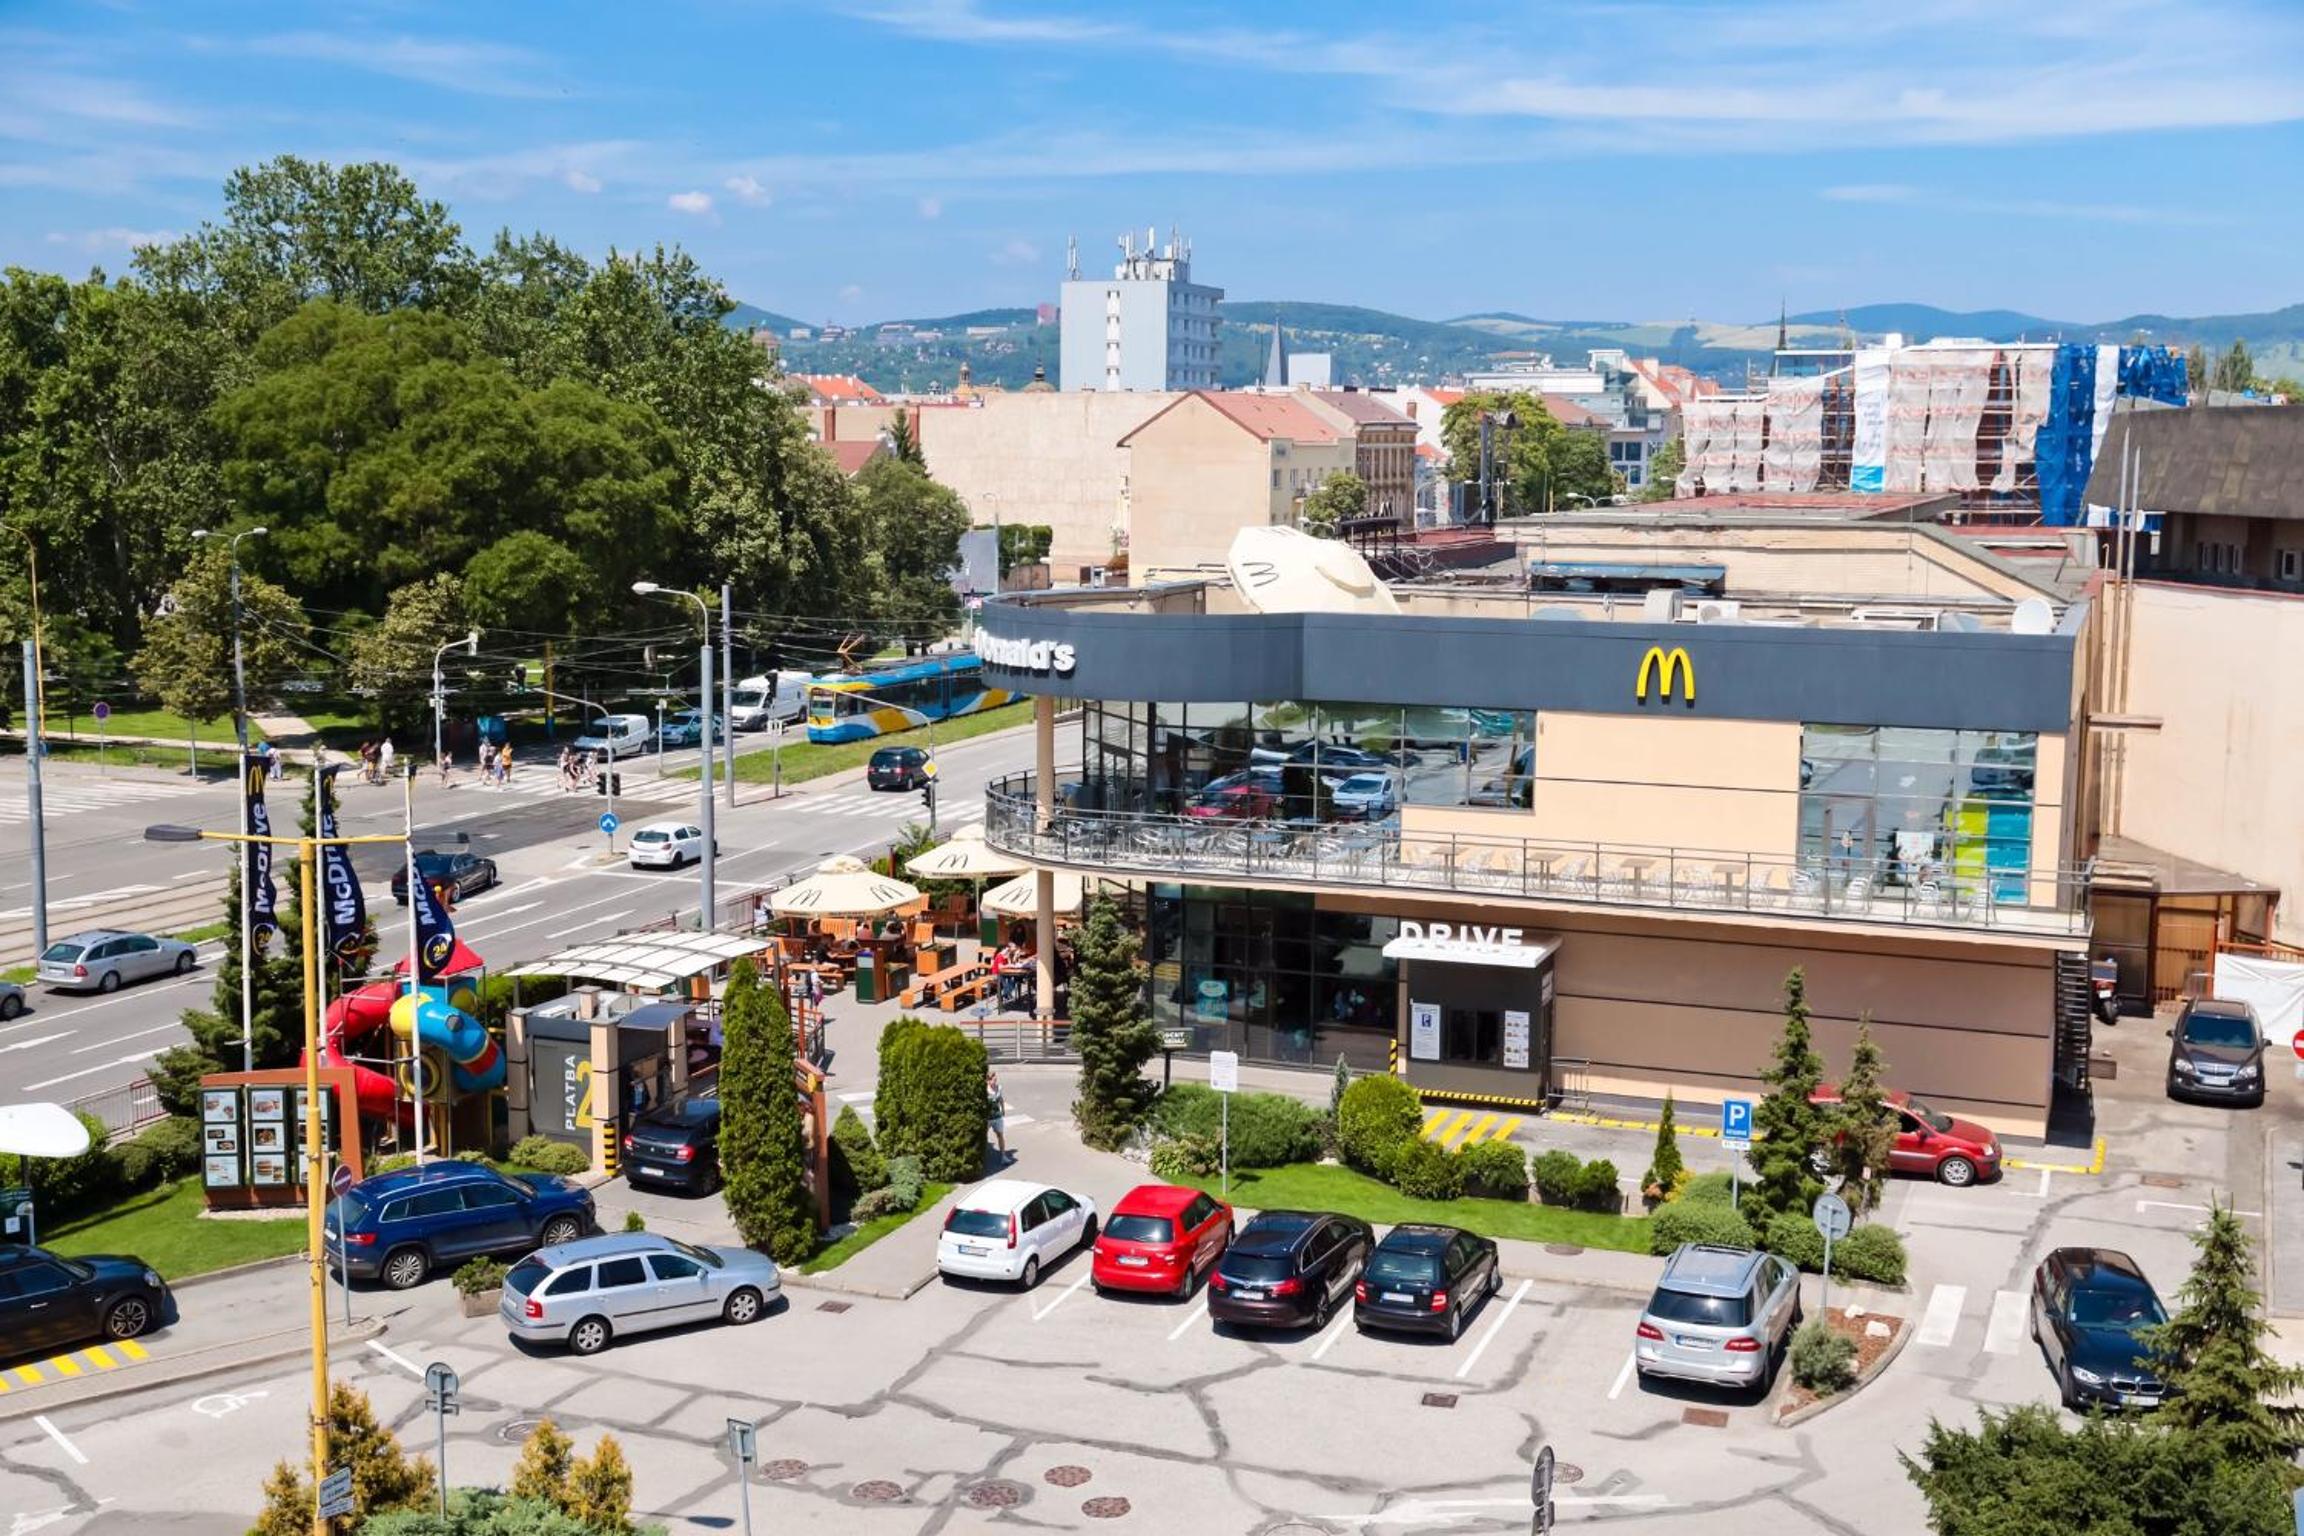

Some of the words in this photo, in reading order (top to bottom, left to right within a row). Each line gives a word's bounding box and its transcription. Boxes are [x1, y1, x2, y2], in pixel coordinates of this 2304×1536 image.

[253, 802, 271, 913] McDrve
[1400, 921, 1524, 947] DRIVE
[565, 1054, 577, 1131] PLATBA
[576, 1061, 592, 1128] 2
